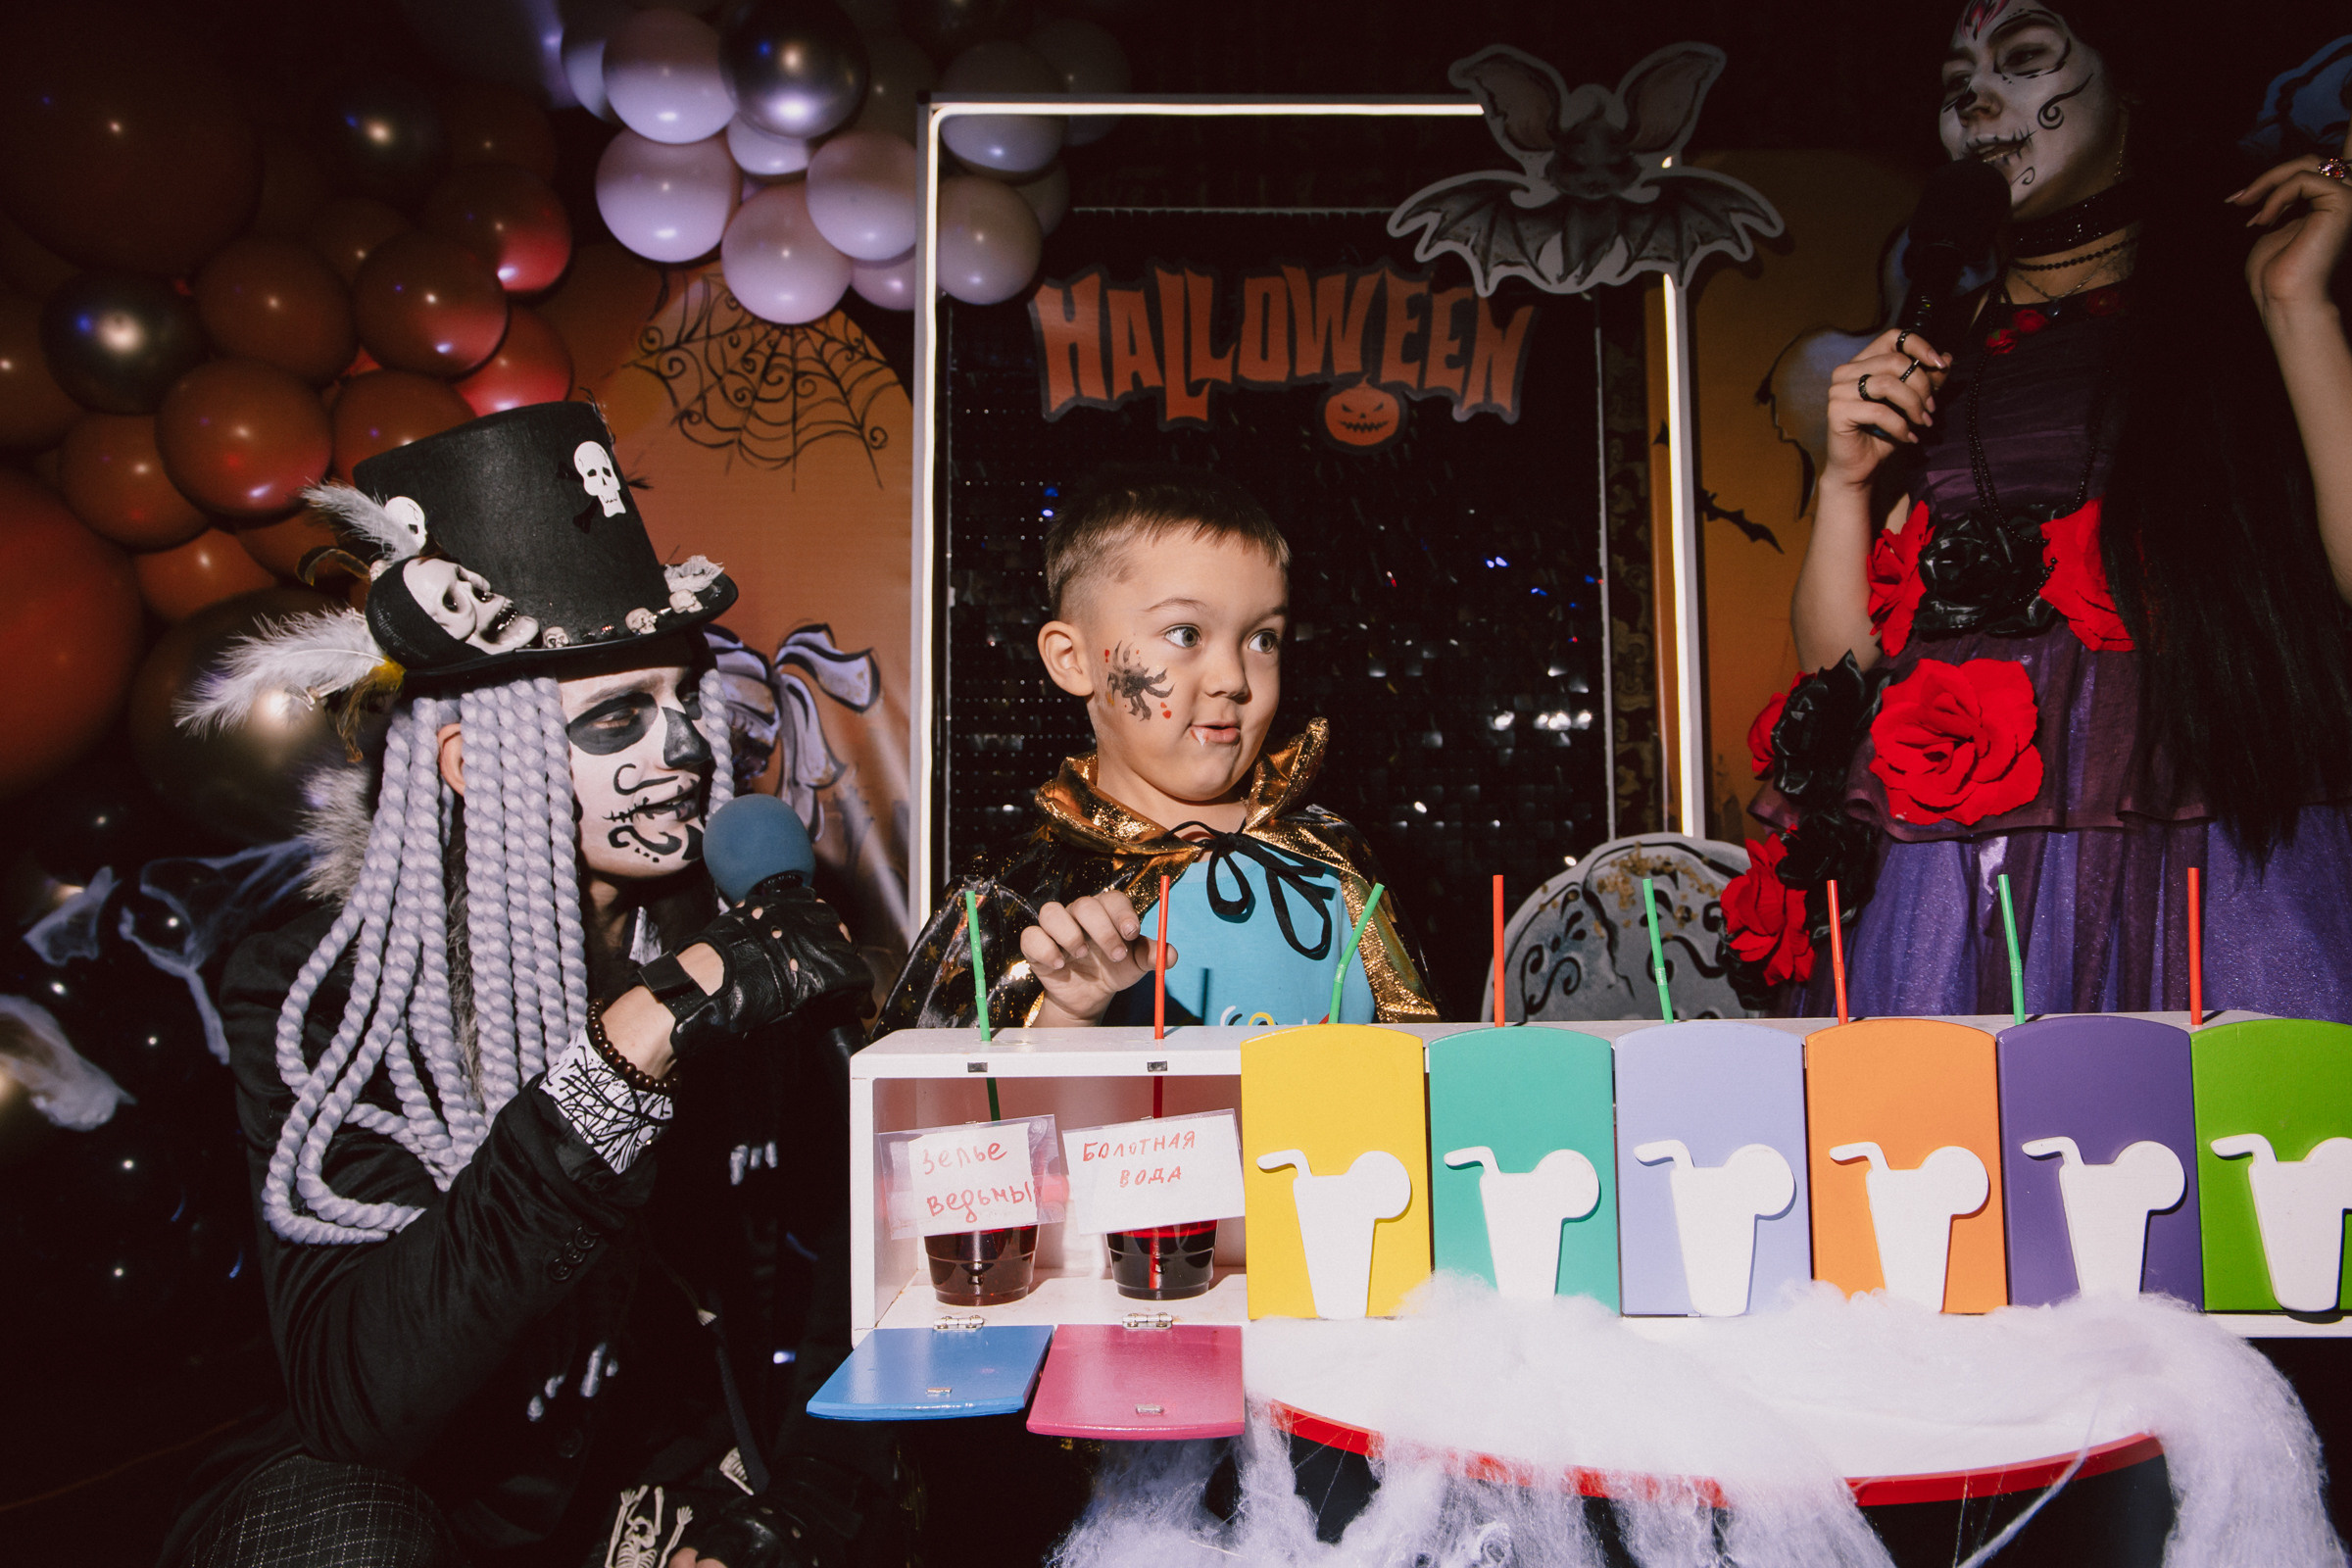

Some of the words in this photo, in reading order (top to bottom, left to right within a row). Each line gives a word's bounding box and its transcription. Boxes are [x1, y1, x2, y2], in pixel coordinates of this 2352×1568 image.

[1032, 265, 1536, 422] HALLOWEEN
[1082, 1130, 1196, 1162] БОЛОТНАЯ
[1118, 1165, 1182, 1189] ВОДА
